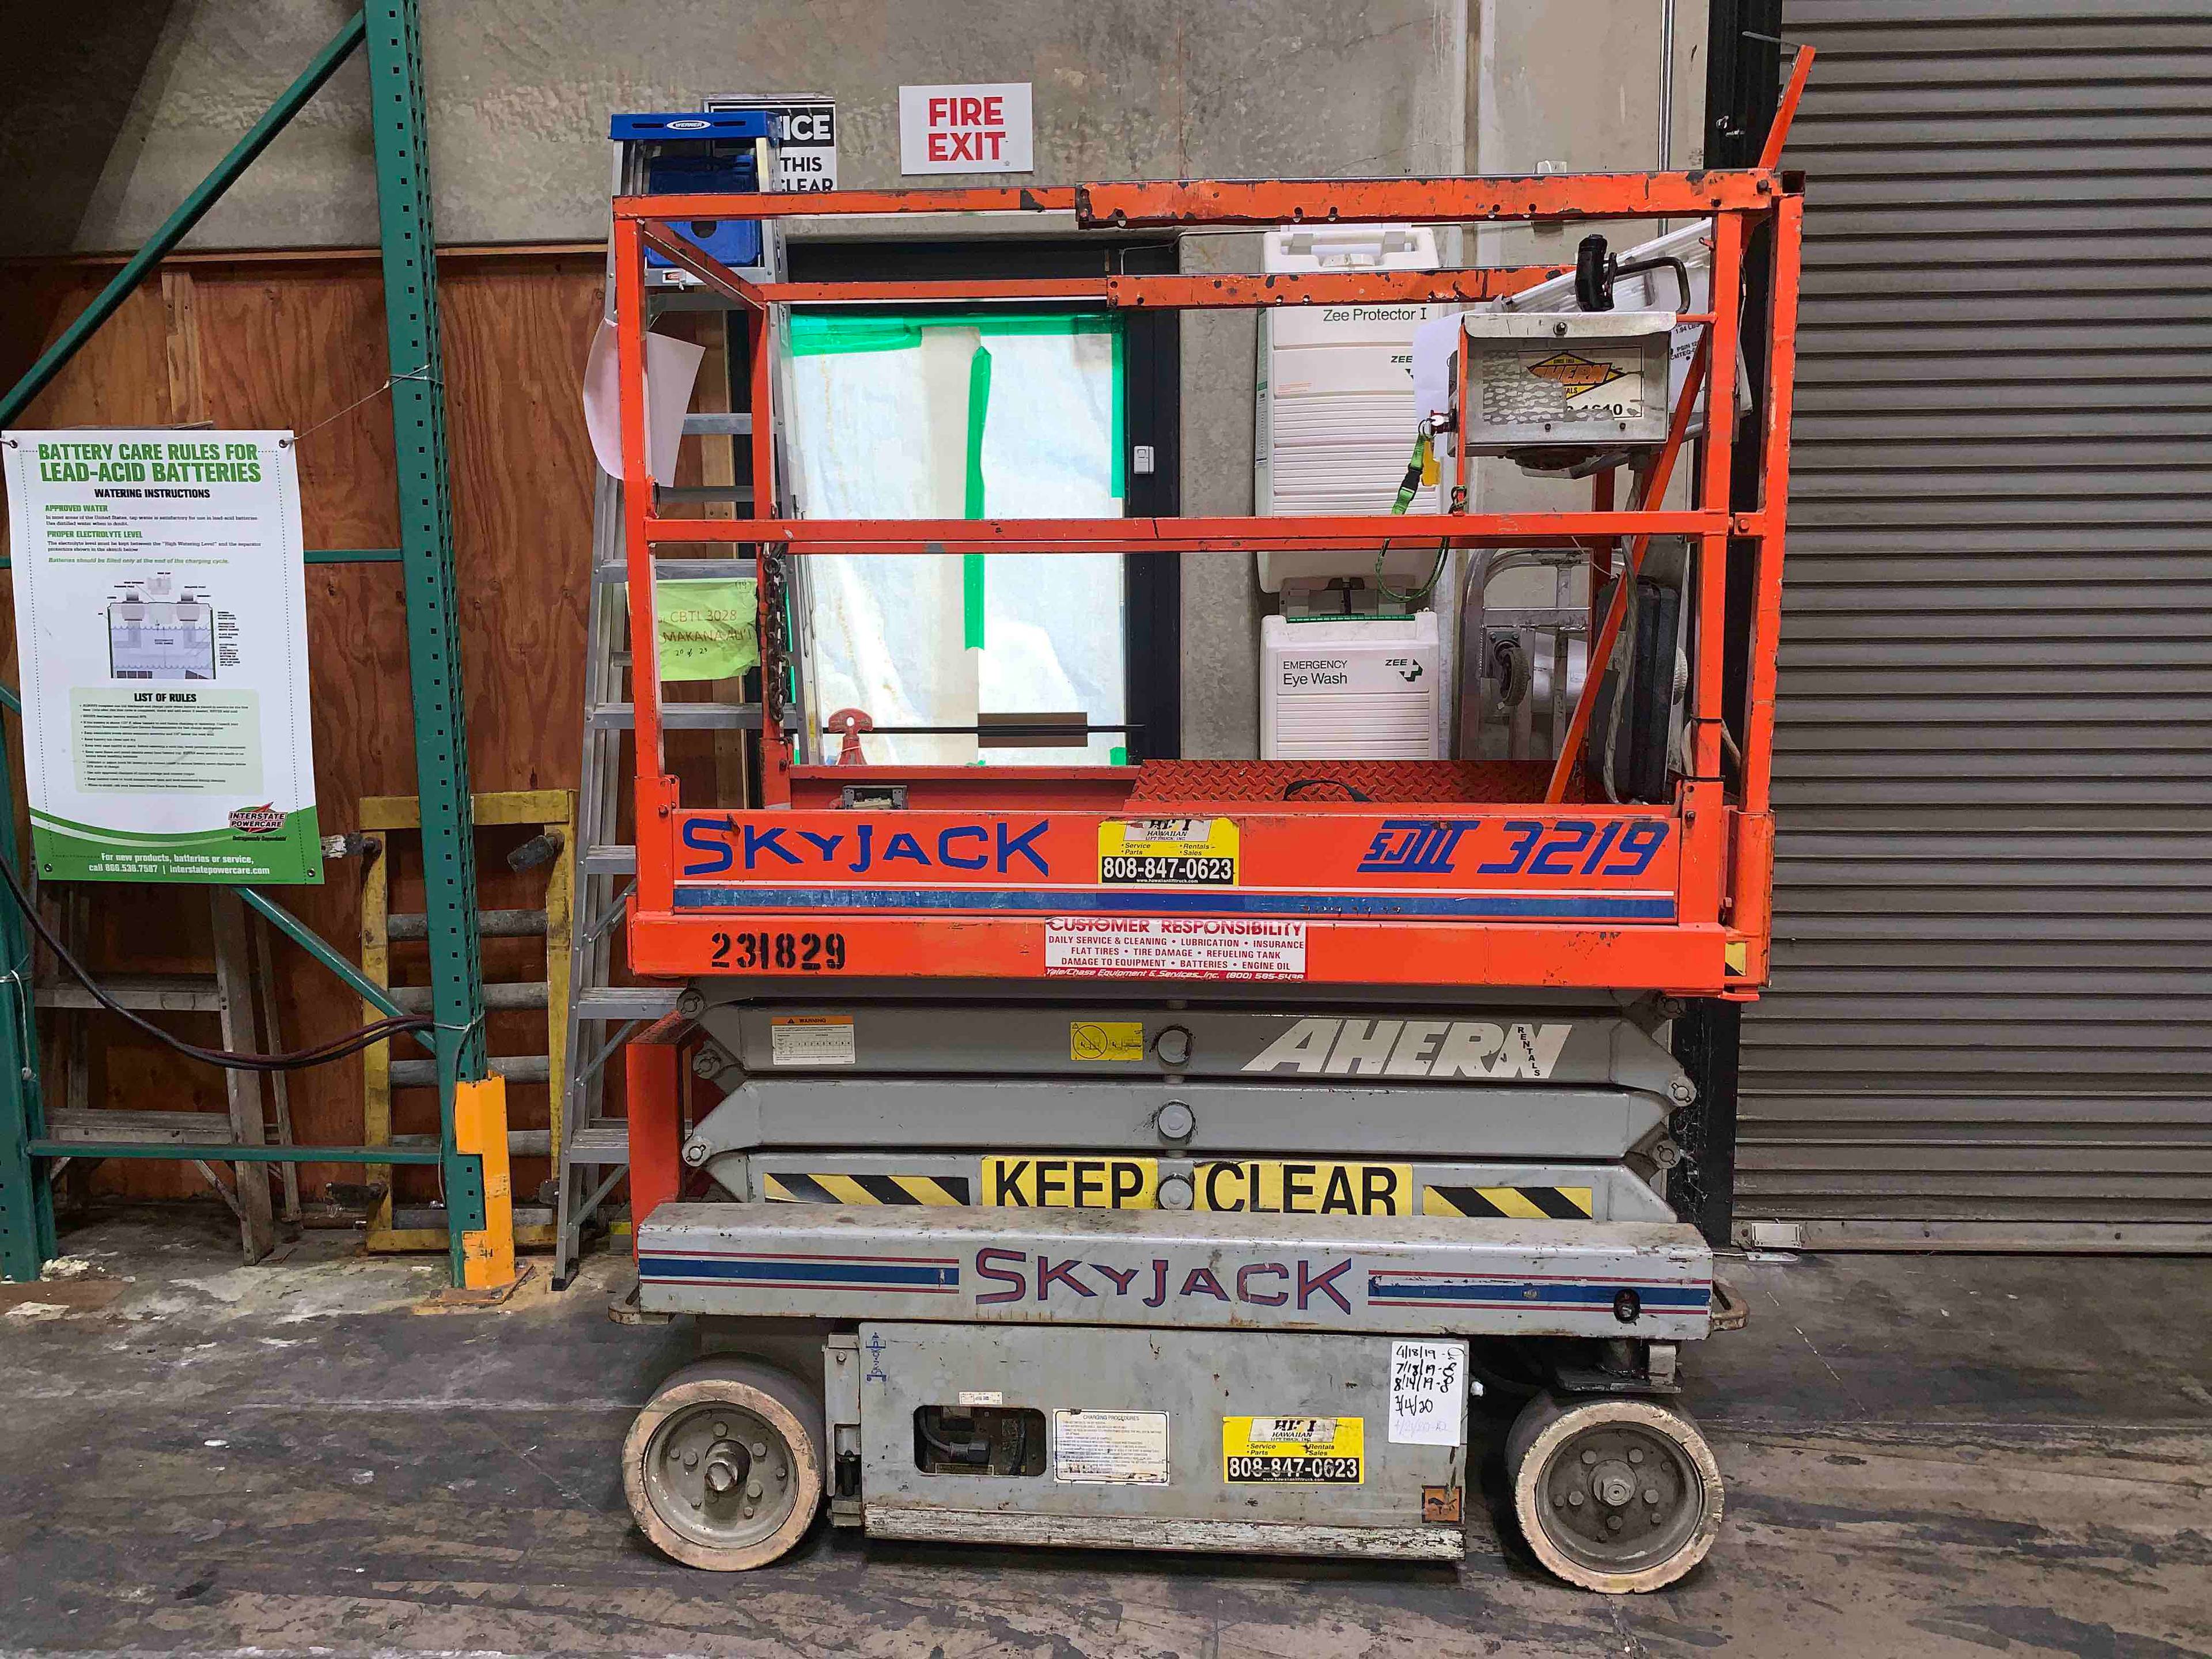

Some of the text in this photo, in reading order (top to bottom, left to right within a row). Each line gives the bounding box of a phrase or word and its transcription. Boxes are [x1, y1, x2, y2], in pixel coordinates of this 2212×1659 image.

[929, 97, 1004, 126] FIRE
[779, 115, 831, 141] ICE
[929, 132, 1006, 161] EXIT
[780, 157, 822, 172] THIS
[782, 178, 833, 192] LEAR
[1323, 309, 1349, 321] Zee
[1353, 308, 1416, 321] Protector
[38, 444, 259, 460] BATTERY CARE RULES FOR
[40, 463, 262, 482] LEAD-ACID BATTERIES
[94, 488, 210, 499] WATERING INSTRUCTIONS
[706, 609, 737, 622] 3028
[662, 631, 724, 642] MAKANA
[1283, 660, 1347, 670] EMERGENCY
[1385, 658, 1408, 666] ZEE
[1283, 672, 1347, 688] Eye Wash
[134, 693, 196, 702] LIST OF RULES
[682, 818, 1048, 877] SKYJACK
[1477, 821, 1669, 875] 3219
[101, 853, 113, 861] For
[134, 854, 172, 863] products,
[173, 854, 209, 862] batteries
[222, 855, 254, 864] service,
[170, 865, 270, 876] interstatepowercare.com
[1103, 857, 1232, 880] 808-847-0623
[1047, 918, 1302, 936] CUSTOMER RESPONSIBILITY
[1124, 937, 1167, 945] CLEANING
[1181, 938, 1239, 946] LUBRICATION
[1253, 940, 1304, 949] INSURANCE
[710, 932, 846, 971] 231829
[1156, 949, 1192, 957] DAMAGE
[1101, 958, 1112, 966] TO
[1115, 959, 1166, 967] EQUIPMENT
[1242, 961, 1274, 969] ENGINE
[1046, 968, 1096, 976] Yale/Chase
[1097, 969, 1147, 977] Equipment
[1240, 1018, 1573, 1079] AHERN
[1517, 1027, 1540, 1077] RENTALS
[995, 1160, 1397, 1216] KEEP CLEAR
[976, 1247, 1351, 1315] SKYJACK
[1229, 1457, 1357, 1478] 808-847-0623
